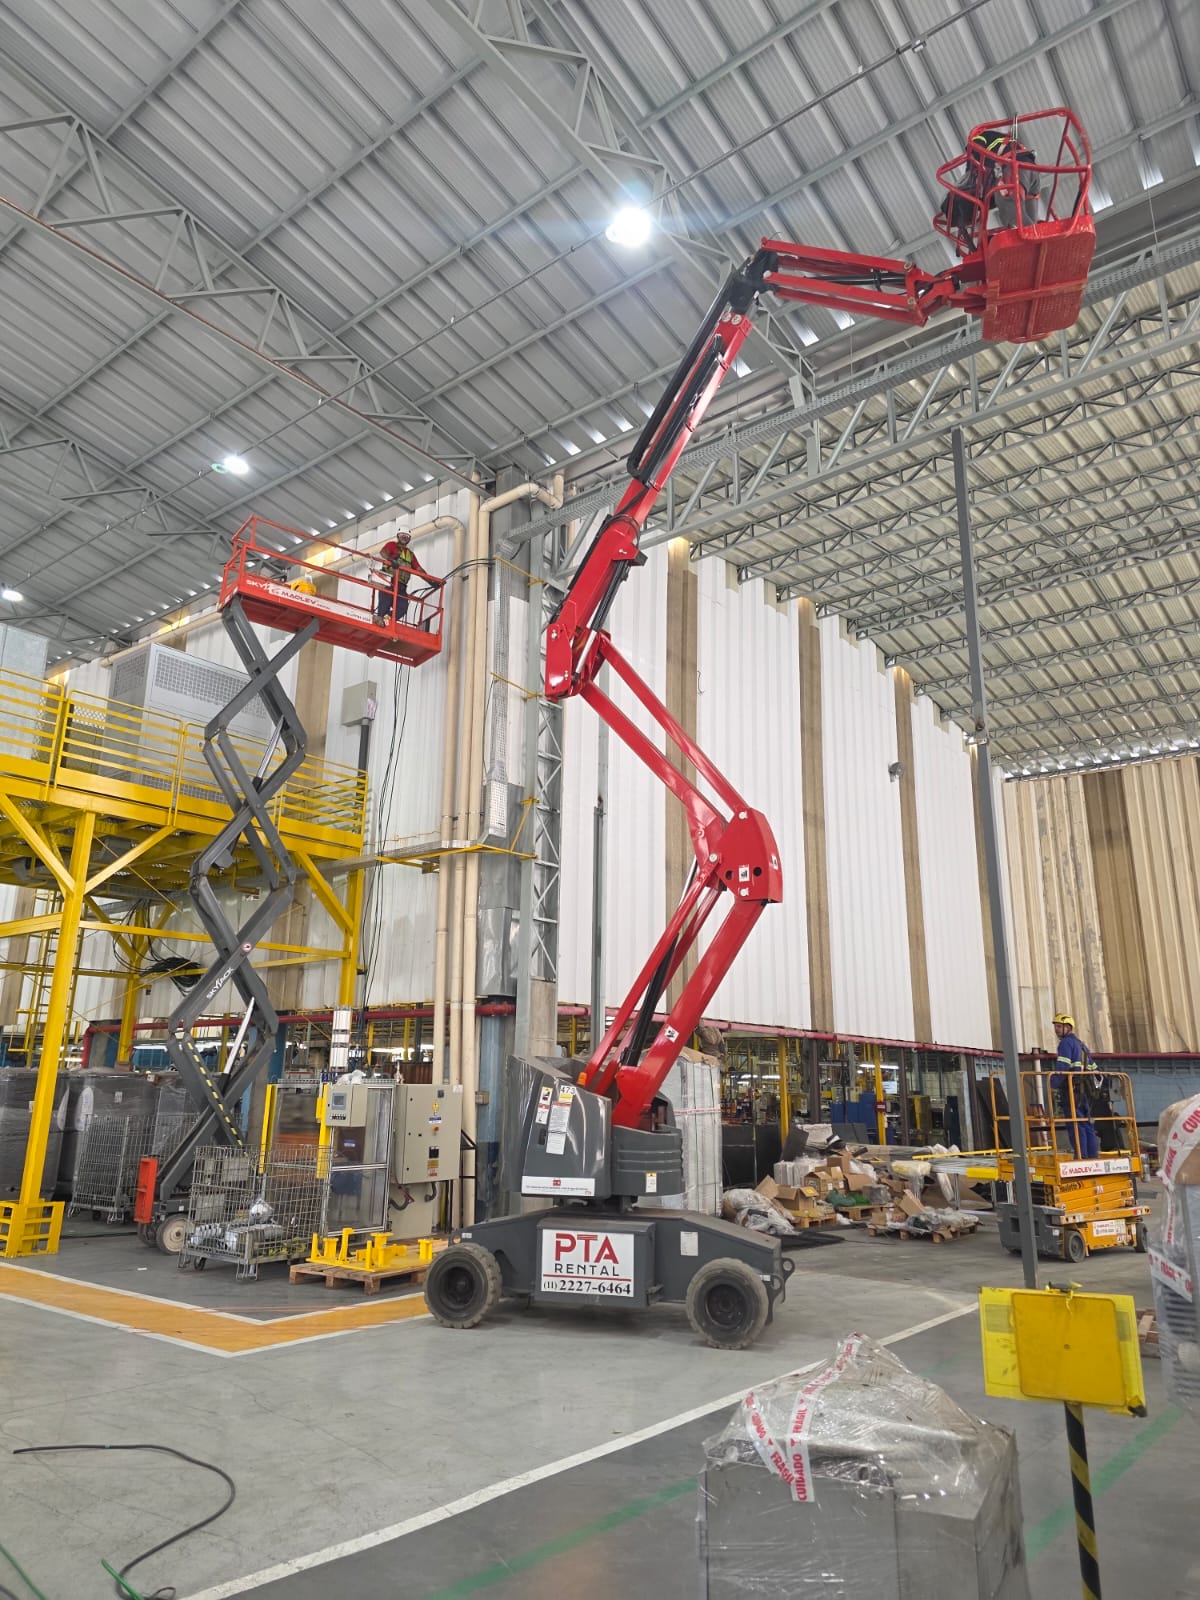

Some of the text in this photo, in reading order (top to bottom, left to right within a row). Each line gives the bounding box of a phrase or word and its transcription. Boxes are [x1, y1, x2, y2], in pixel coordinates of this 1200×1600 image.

[560, 1086, 576, 1095] 473
[1069, 1166, 1092, 1174] MADLEY
[555, 1232, 620, 1264] PTA
[554, 1263, 620, 1277] RENTAL
[543, 1279, 631, 1295] (11) 2227-6464
[792, 1453, 807, 1502] CUIDADO
